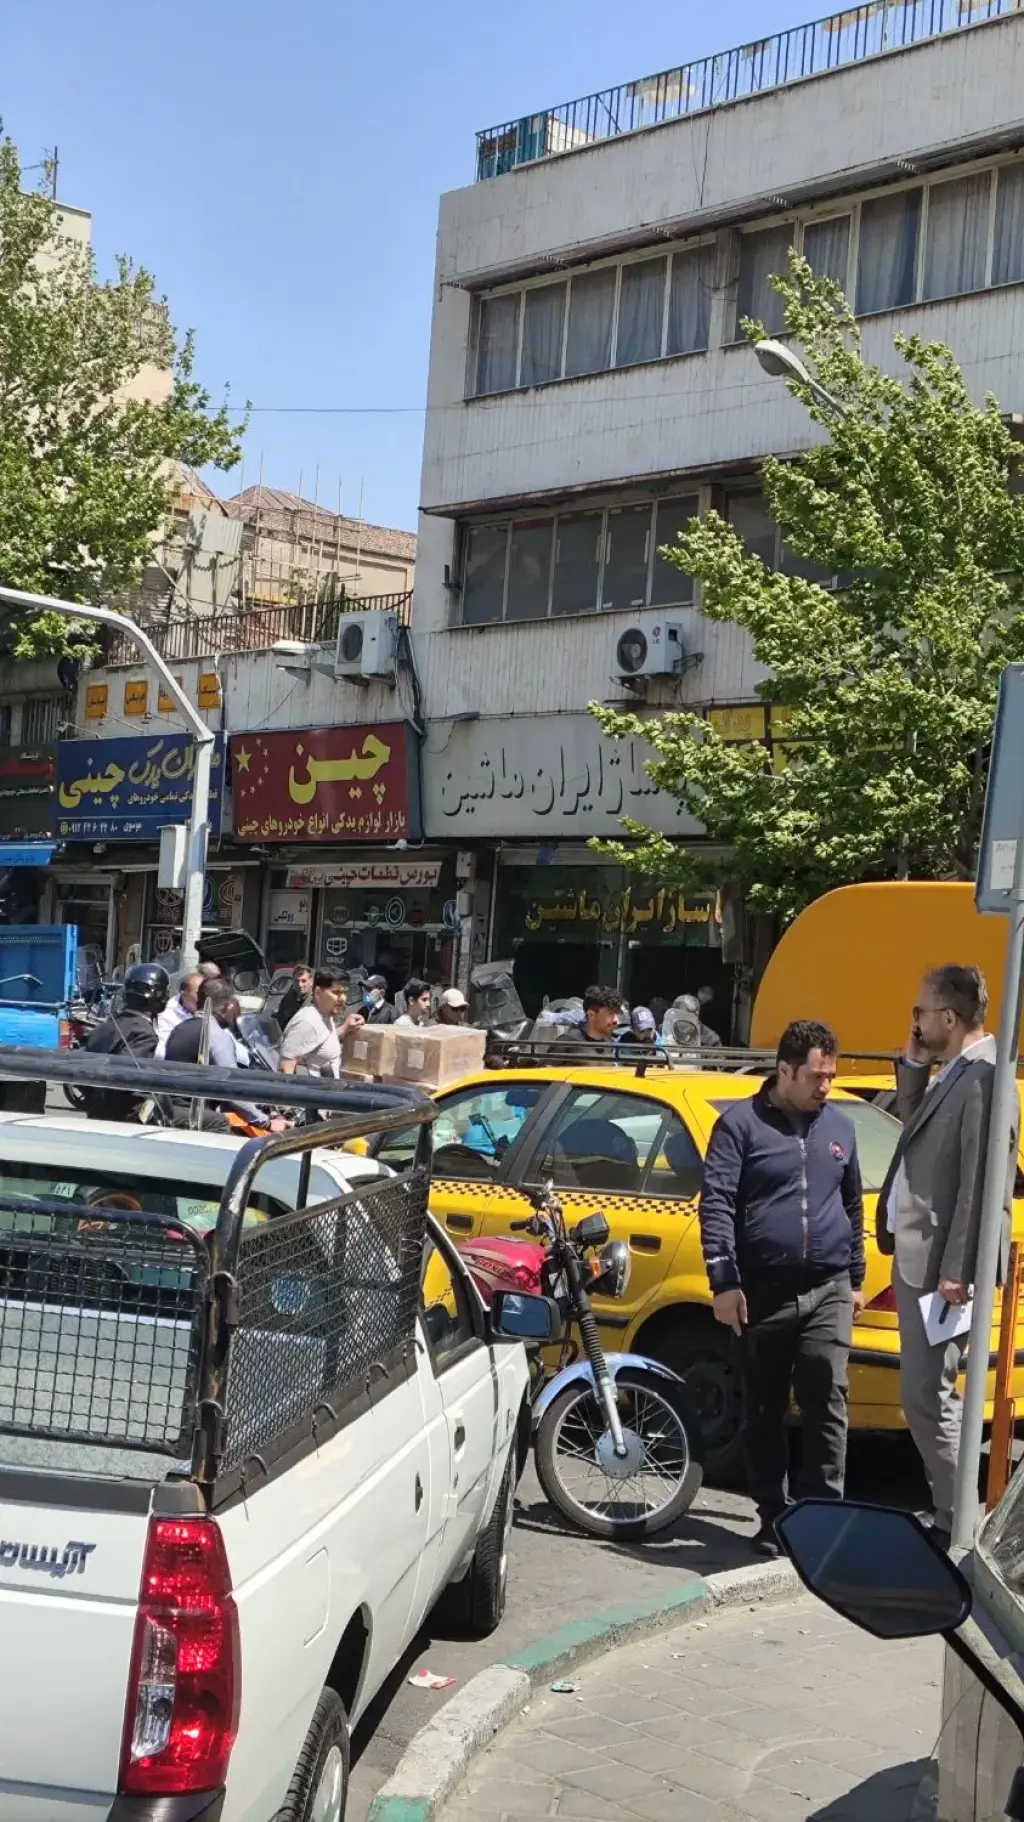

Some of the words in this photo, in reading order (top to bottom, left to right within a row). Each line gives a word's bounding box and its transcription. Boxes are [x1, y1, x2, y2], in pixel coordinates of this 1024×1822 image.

[289, 734, 391, 805] چین
[532, 743, 604, 816] ایران
[58, 757, 125, 809] چینی
[442, 747, 525, 817] ماشین
[237, 817, 260, 837] چینی
[260, 813, 305, 837] خودروهای
[307, 813, 329, 835] انواع
[331, 812, 356, 834] یدکی
[357, 811, 381, 833] لوازم
[385, 811, 406, 833] بازار
[358, 865, 399, 880] قطعات
[400, 866, 438, 886] بورس
[525, 887, 600, 931] ماشین
